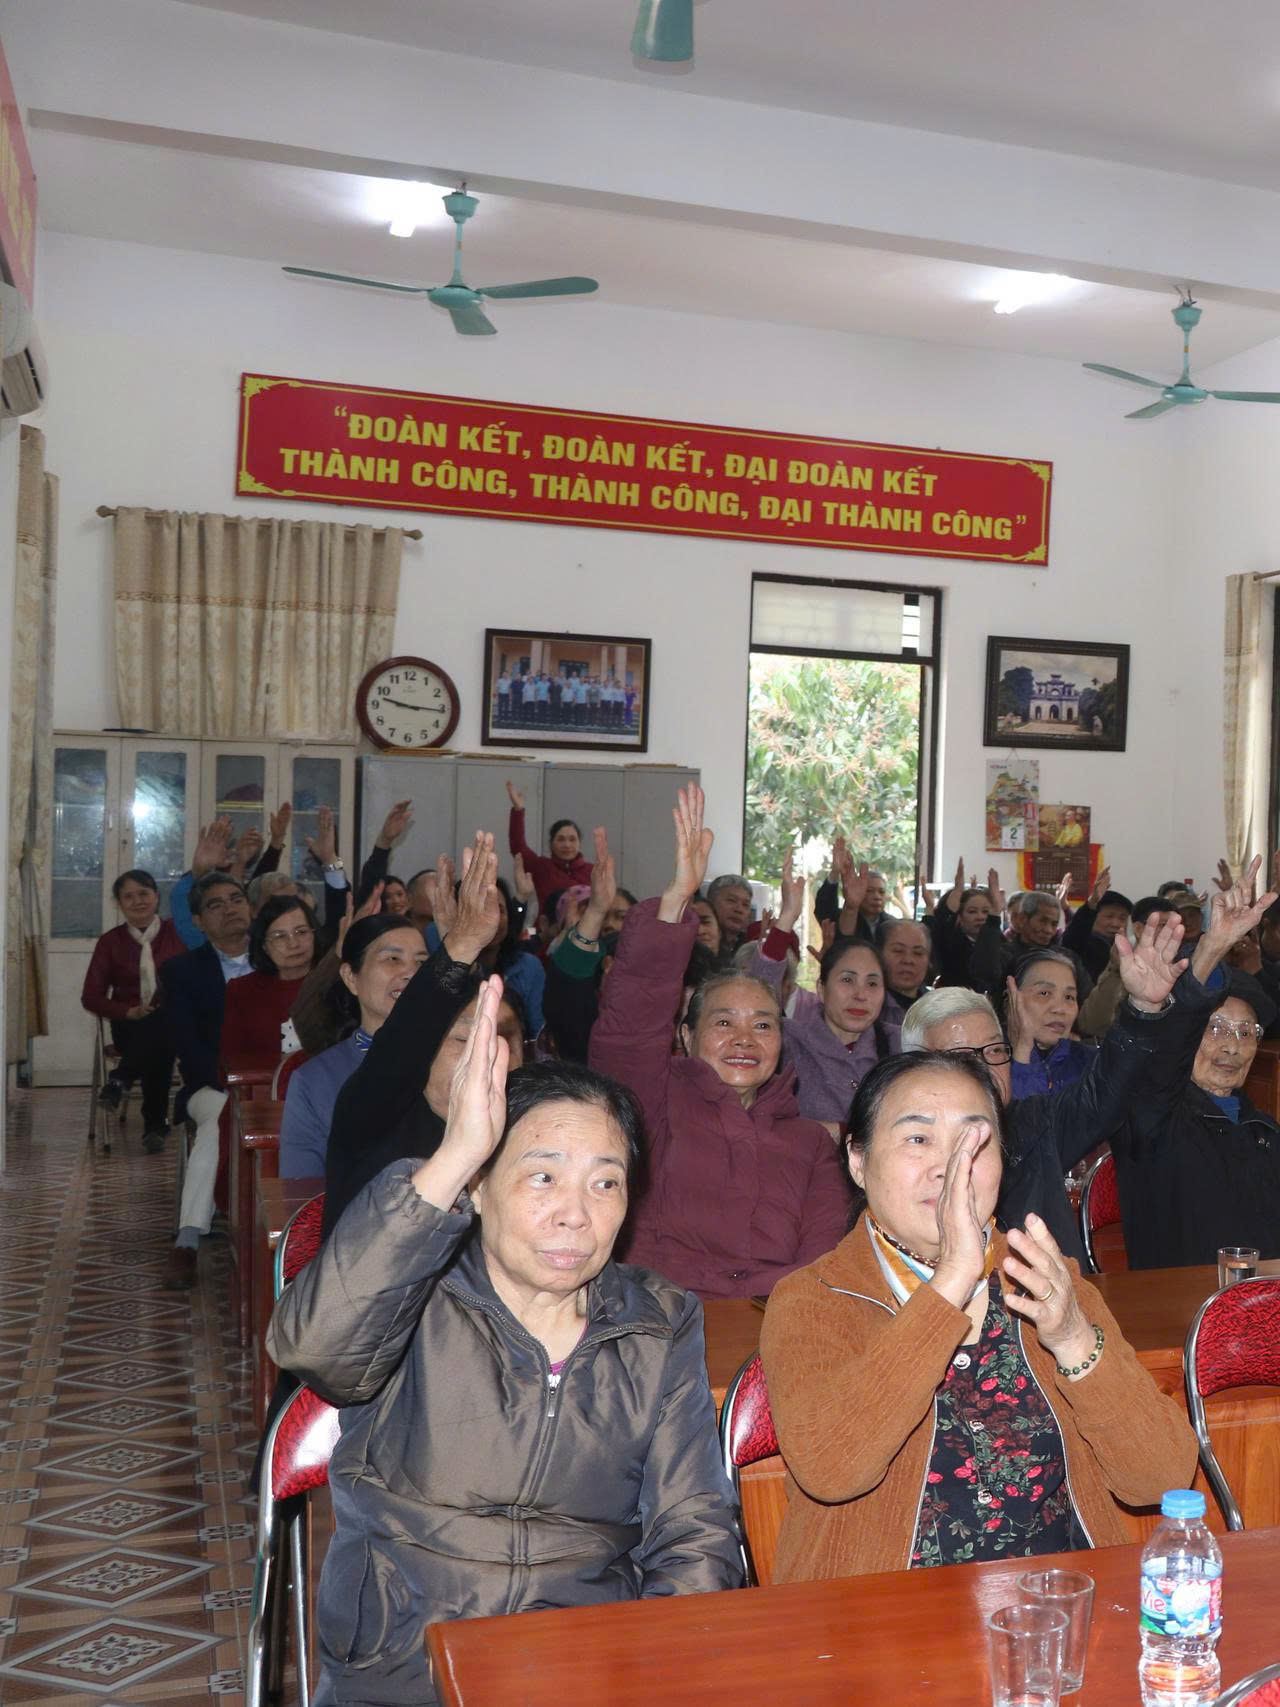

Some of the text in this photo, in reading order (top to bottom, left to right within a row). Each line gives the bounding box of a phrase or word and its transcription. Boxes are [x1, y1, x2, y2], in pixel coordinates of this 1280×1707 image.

[459, 421, 531, 460] KẾT,
[543, 434, 635, 468] ĐOÀN
[646, 440, 714, 478] KẾT,
[725, 453, 778, 485] ĐẠI
[788, 460, 873, 491] ĐOÀN
[883, 465, 938, 497] KẾT
[280, 447, 400, 485] THÀNH
[411, 459, 518, 499] CÔNG,
[530, 471, 639, 507] THÀNH
[651, 483, 749, 521] CÔNG,
[759, 495, 811, 527] ĐẠI
[822, 500, 922, 533] THÀNH
[390, 675, 400, 684] 11
[404, 671, 416, 680] 12
[424, 677, 428, 686] 1
[378, 687, 390, 696] 10
[434, 688, 441, 697] 2
[372, 700, 380, 709] 9
[439, 704, 446, 713] 3
[377, 716, 385, 725] 8
[432, 720, 439, 729] 4
[388, 728, 396, 737] 7
[421, 730, 428, 739] 5
[404, 733, 412, 742] 6
[1010, 826, 1018, 840] 2
